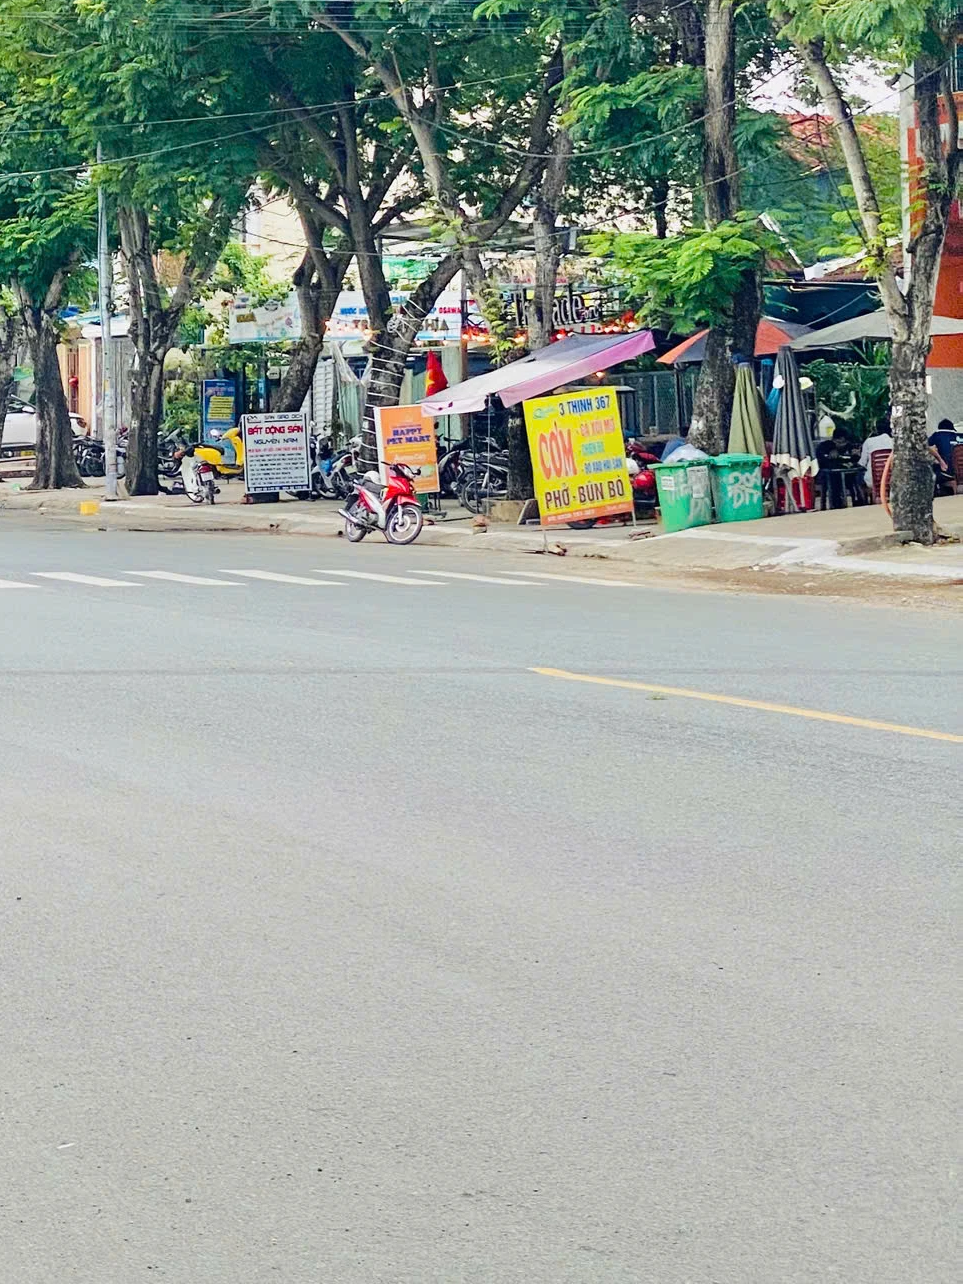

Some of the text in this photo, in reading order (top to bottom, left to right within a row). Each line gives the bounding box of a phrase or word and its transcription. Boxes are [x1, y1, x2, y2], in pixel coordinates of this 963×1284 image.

[559, 403, 565, 416] 3
[595, 395, 610, 410] 367
[545, 483, 570, 510] PHỞ
[608, 474, 625, 501] BÒ
